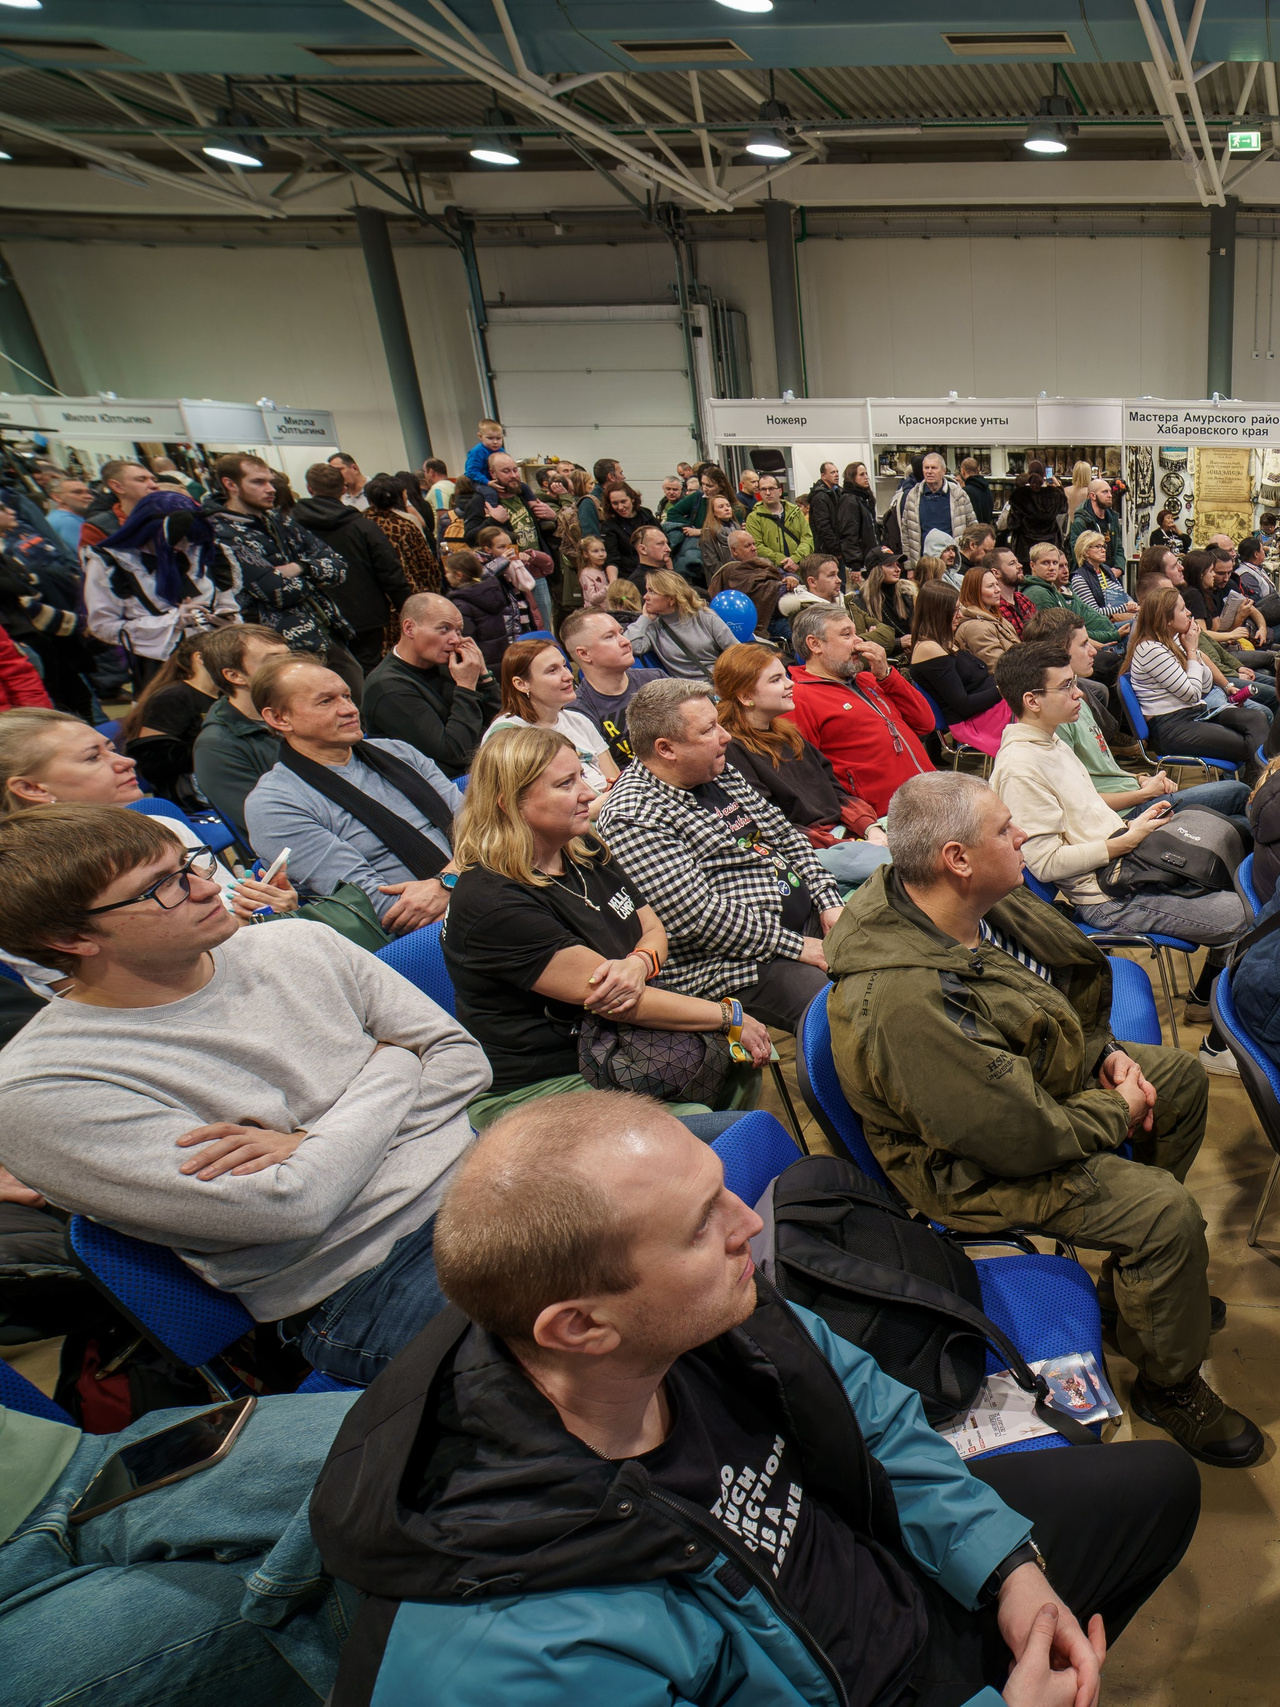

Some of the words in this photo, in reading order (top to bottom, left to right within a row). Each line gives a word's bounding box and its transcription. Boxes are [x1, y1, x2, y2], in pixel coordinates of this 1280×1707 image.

[62, 412, 97, 423] Милла
[99, 412, 153, 425] Юлтыгина
[283, 416, 316, 427] Милла
[766, 415, 807, 426] Ножеяр
[898, 414, 978, 427] Красноярские
[980, 416, 1009, 428] унты
[1129, 411, 1179, 424] Мастера
[1183, 412, 1247, 425] Амурского
[276, 425, 326, 436] Юлтыгина
[1156, 423, 1239, 437] Хабаровского
[1242, 426, 1269, 437] края
[764, 1507, 782, 1526] A
[760, 1526, 777, 1554] IS
